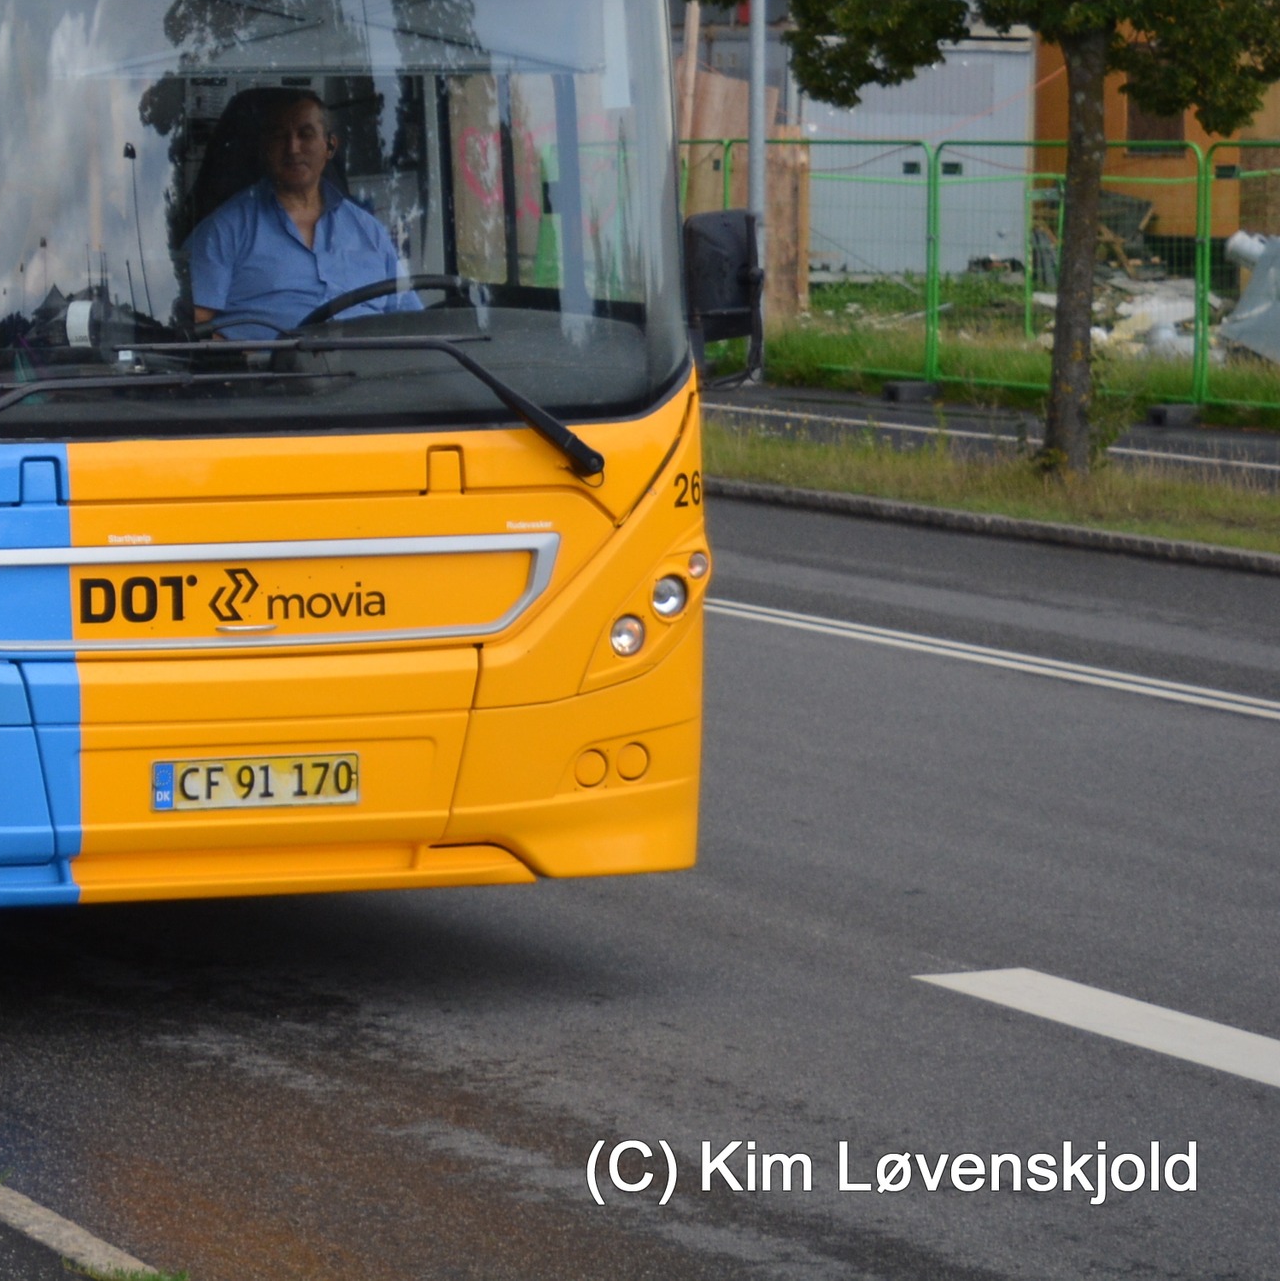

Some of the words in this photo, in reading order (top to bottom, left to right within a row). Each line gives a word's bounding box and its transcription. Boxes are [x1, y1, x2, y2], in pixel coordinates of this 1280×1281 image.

[79, 574, 198, 624] DOT
[267, 581, 386, 621] movia
[155, 790, 171, 803] DK
[178, 766, 225, 801] CF
[236, 764, 274, 799] 91
[292, 760, 354, 797] 170
